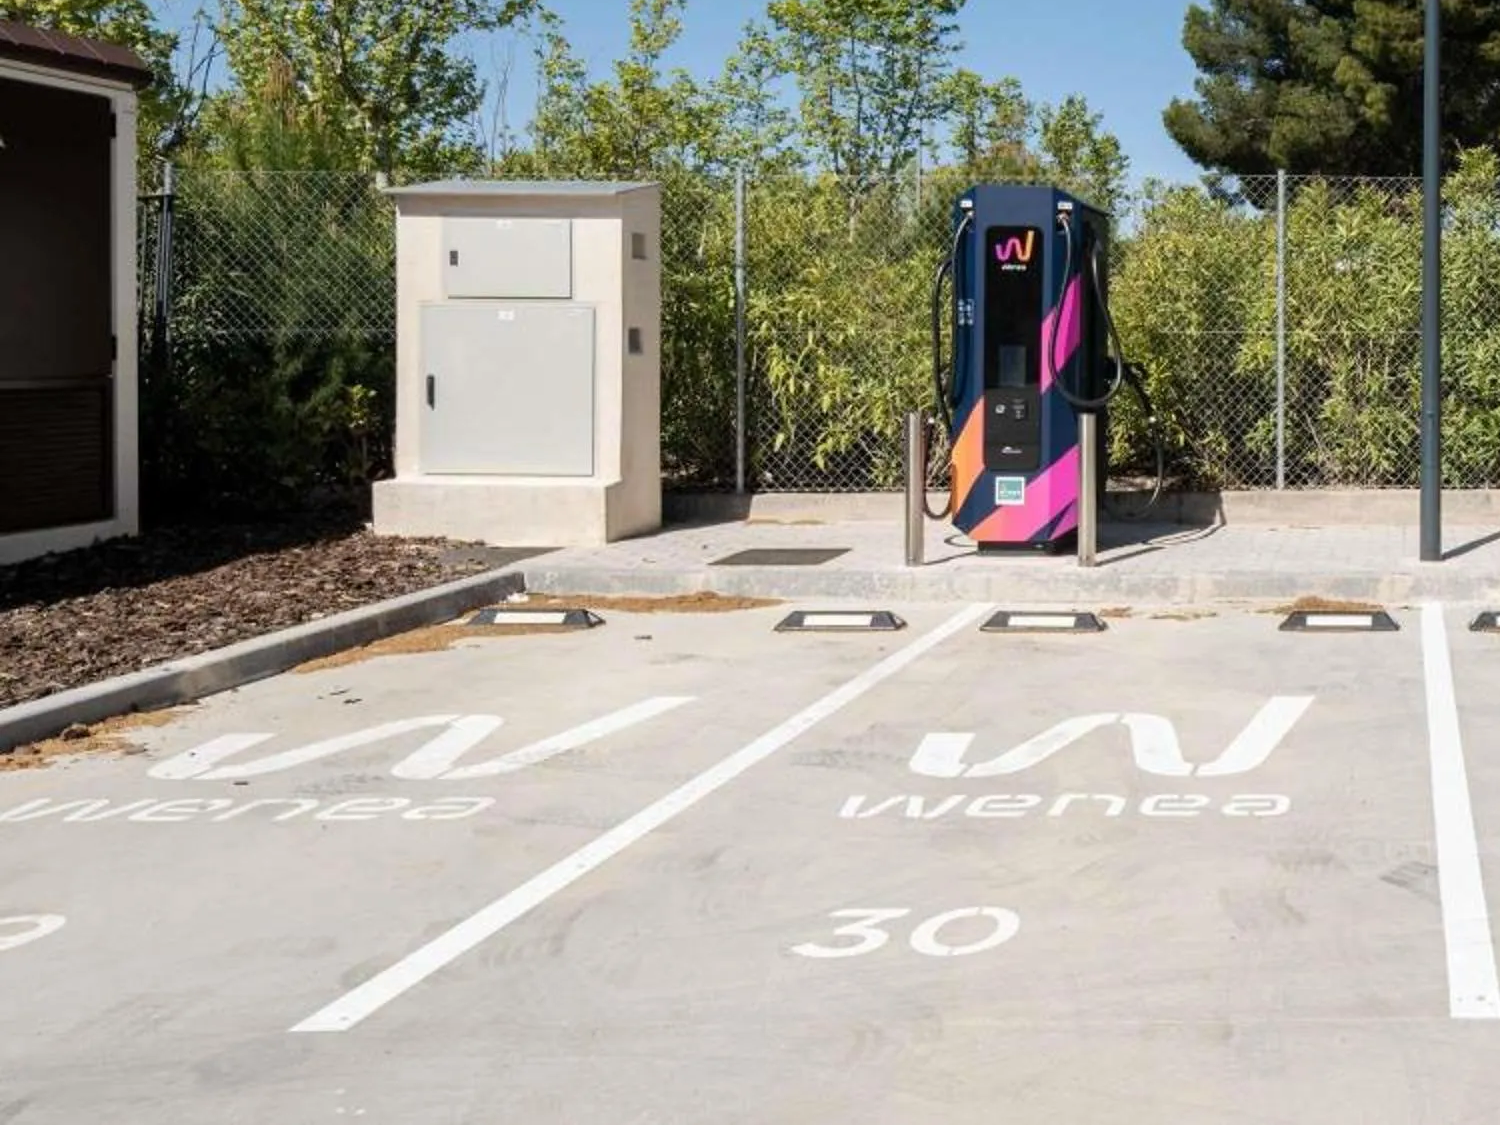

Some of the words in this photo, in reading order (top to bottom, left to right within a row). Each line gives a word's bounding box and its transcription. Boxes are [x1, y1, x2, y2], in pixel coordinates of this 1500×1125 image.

[0, 797, 498, 823] wenea
[836, 793, 1293, 819] wenea
[792, 906, 1021, 958] 30
